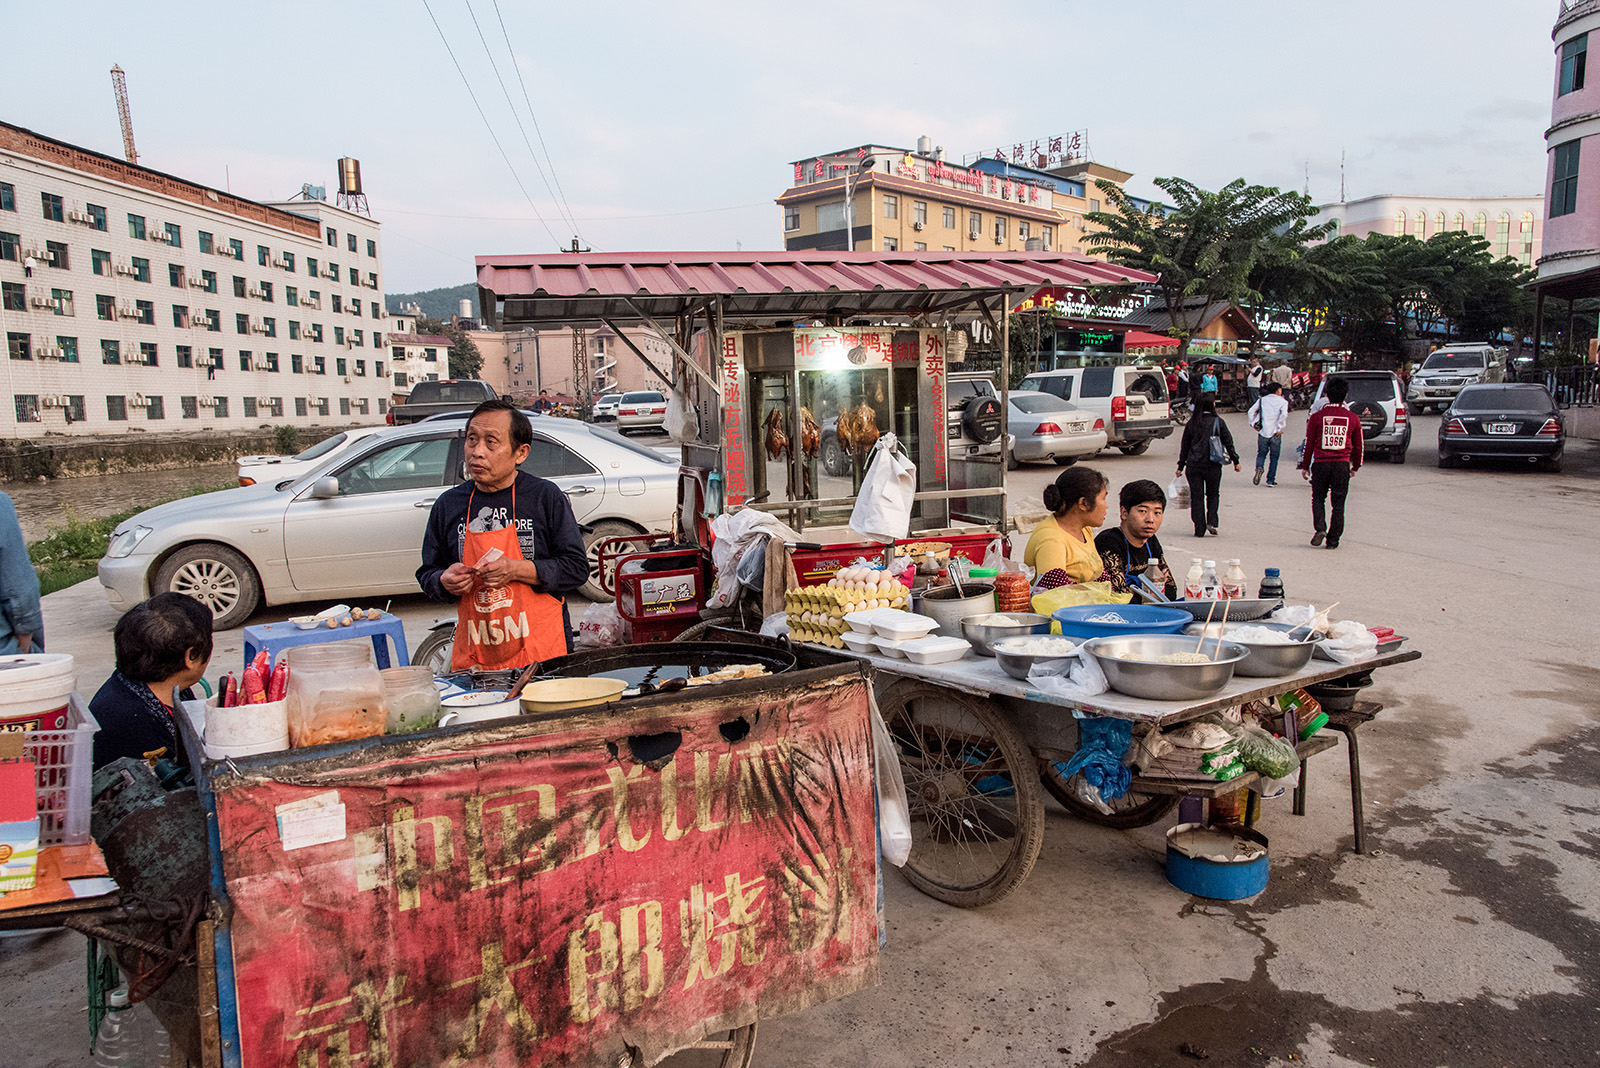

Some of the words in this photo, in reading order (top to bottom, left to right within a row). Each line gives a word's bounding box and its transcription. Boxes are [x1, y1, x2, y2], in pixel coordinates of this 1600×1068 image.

[925, 335, 945, 376] 外卖
[1323, 426, 1347, 436] BULLS
[1324, 436, 1345, 447] 1966
[655, 582, 695, 604] 广益
[467, 611, 530, 647] MSM
